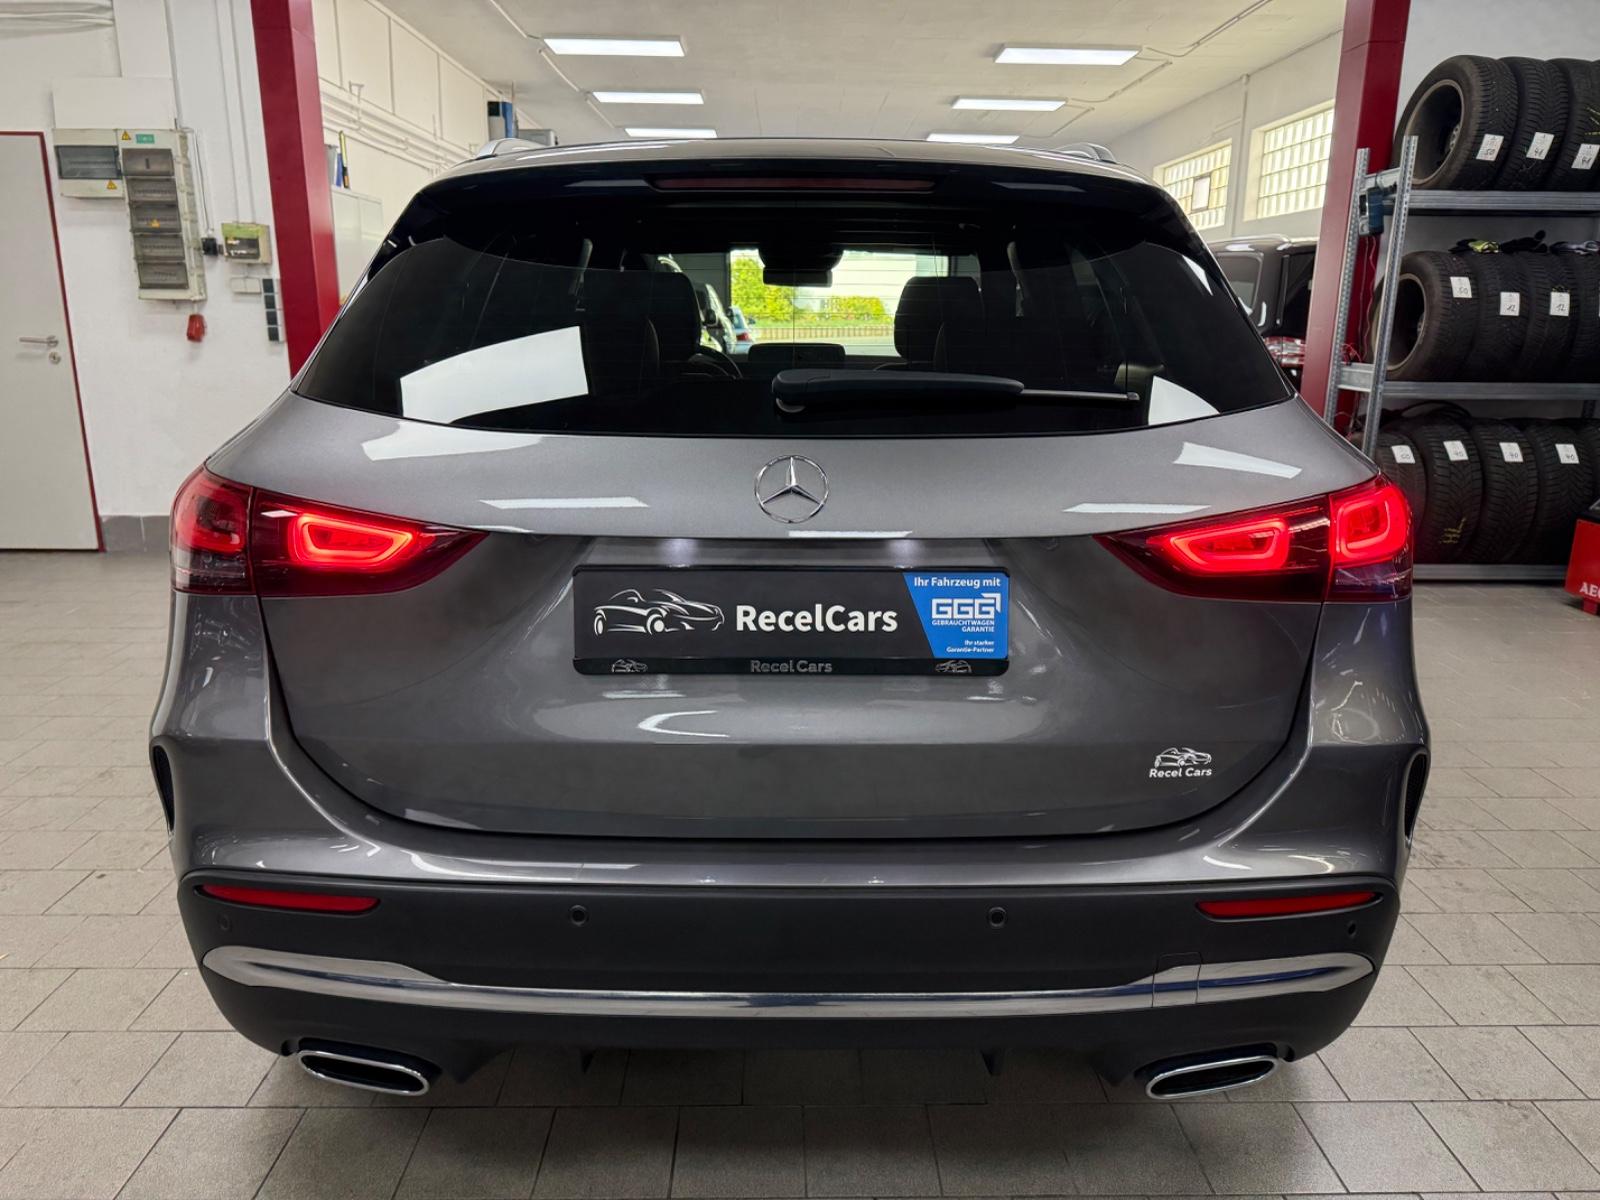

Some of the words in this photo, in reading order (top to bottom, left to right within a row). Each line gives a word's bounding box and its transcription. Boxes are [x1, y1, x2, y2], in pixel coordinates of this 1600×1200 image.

[914, 577, 929, 587] Ihr
[931, 577, 980, 589] Fahrzeug
[982, 577, 1001, 587] mit
[1579, 581, 1600, 599] AE
[931, 598, 995, 619] GGG
[736, 603, 898, 632] RecelCars
[750, 660, 794, 673] Recel
[796, 660, 832, 673] Cars
[1149, 768, 1182, 778] Recel
[1185, 767, 1212, 777] Cars
